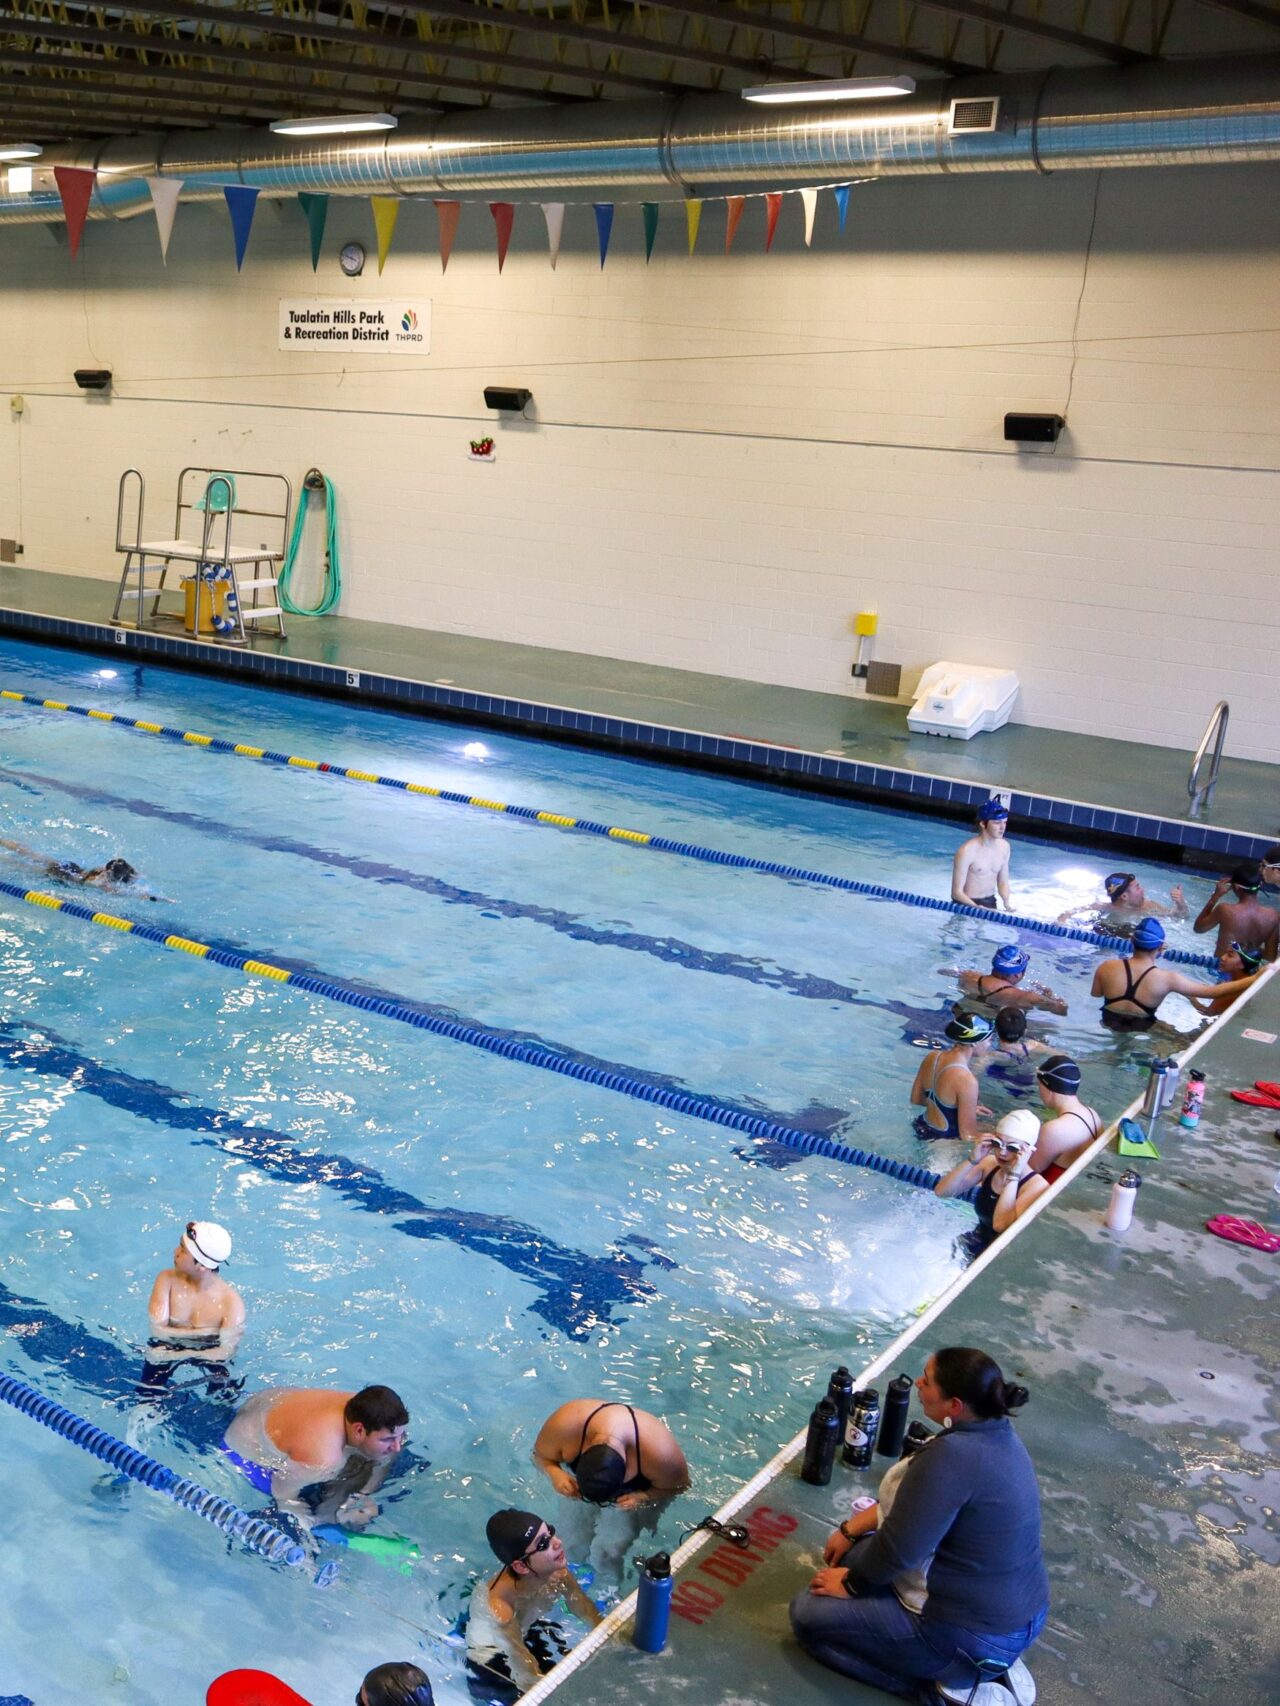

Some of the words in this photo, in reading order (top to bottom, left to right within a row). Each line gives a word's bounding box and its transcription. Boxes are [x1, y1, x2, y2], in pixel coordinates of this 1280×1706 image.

[289, 310, 330, 324] Tualatin
[333, 311, 356, 324] Hills
[359, 312, 384, 325] Park
[284, 327, 292, 339] &
[295, 327, 349, 340] Recreation
[352, 328, 390, 341] District
[396, 333, 424, 342] THPRD
[697, 1505, 800, 1589] DIVING
[671, 1579, 725, 1626] NO
